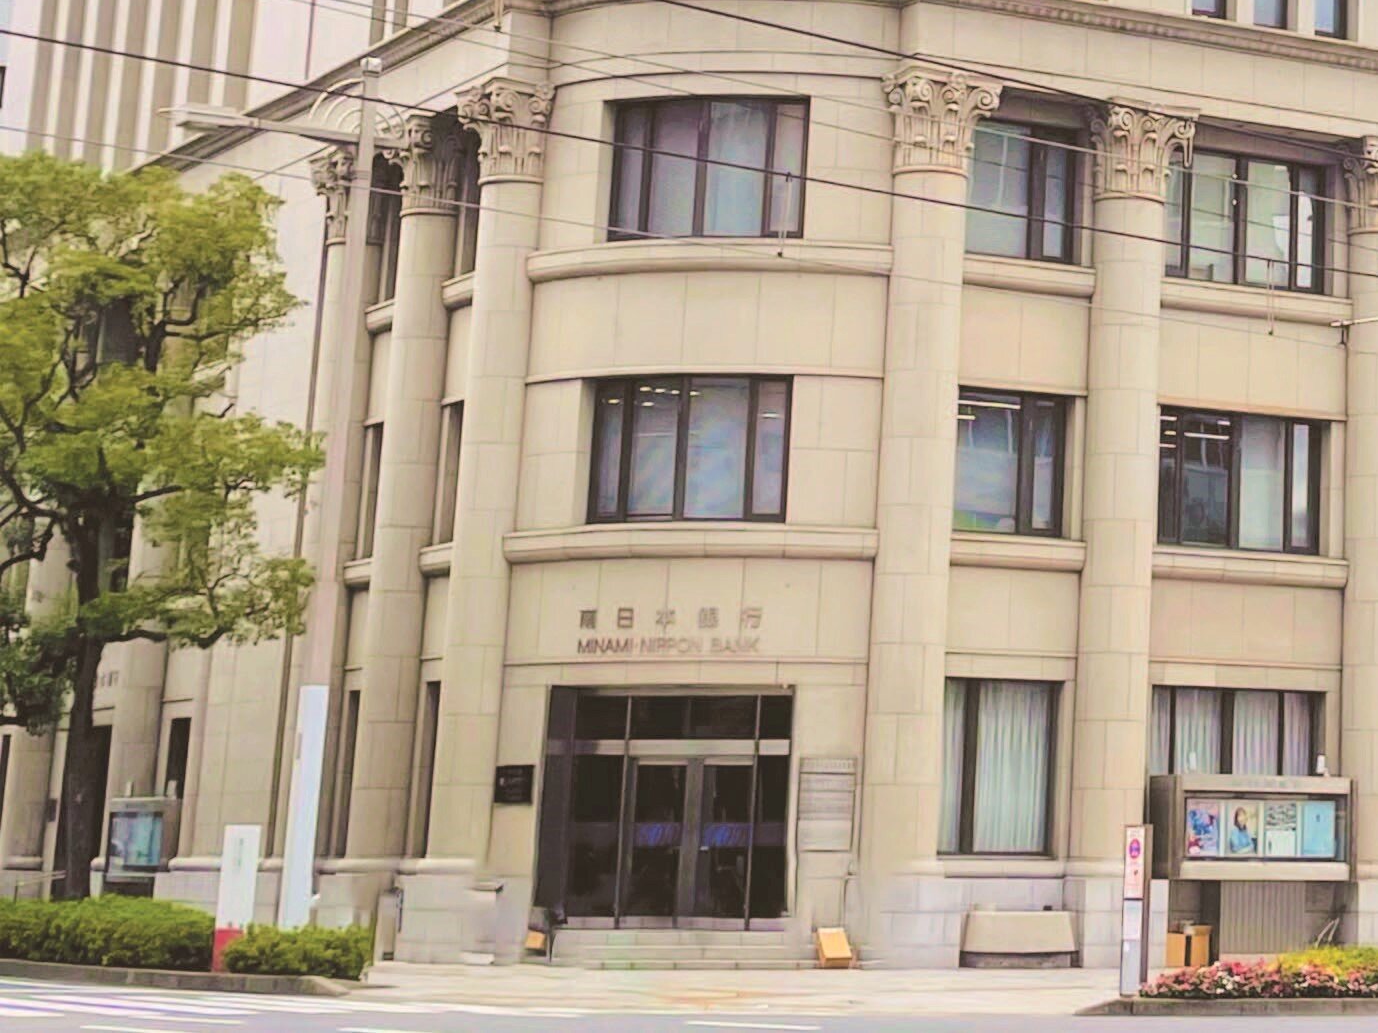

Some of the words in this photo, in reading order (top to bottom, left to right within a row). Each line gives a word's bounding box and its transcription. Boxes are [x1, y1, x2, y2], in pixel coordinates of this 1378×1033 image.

[579, 607, 763, 630] 南日本銀行
